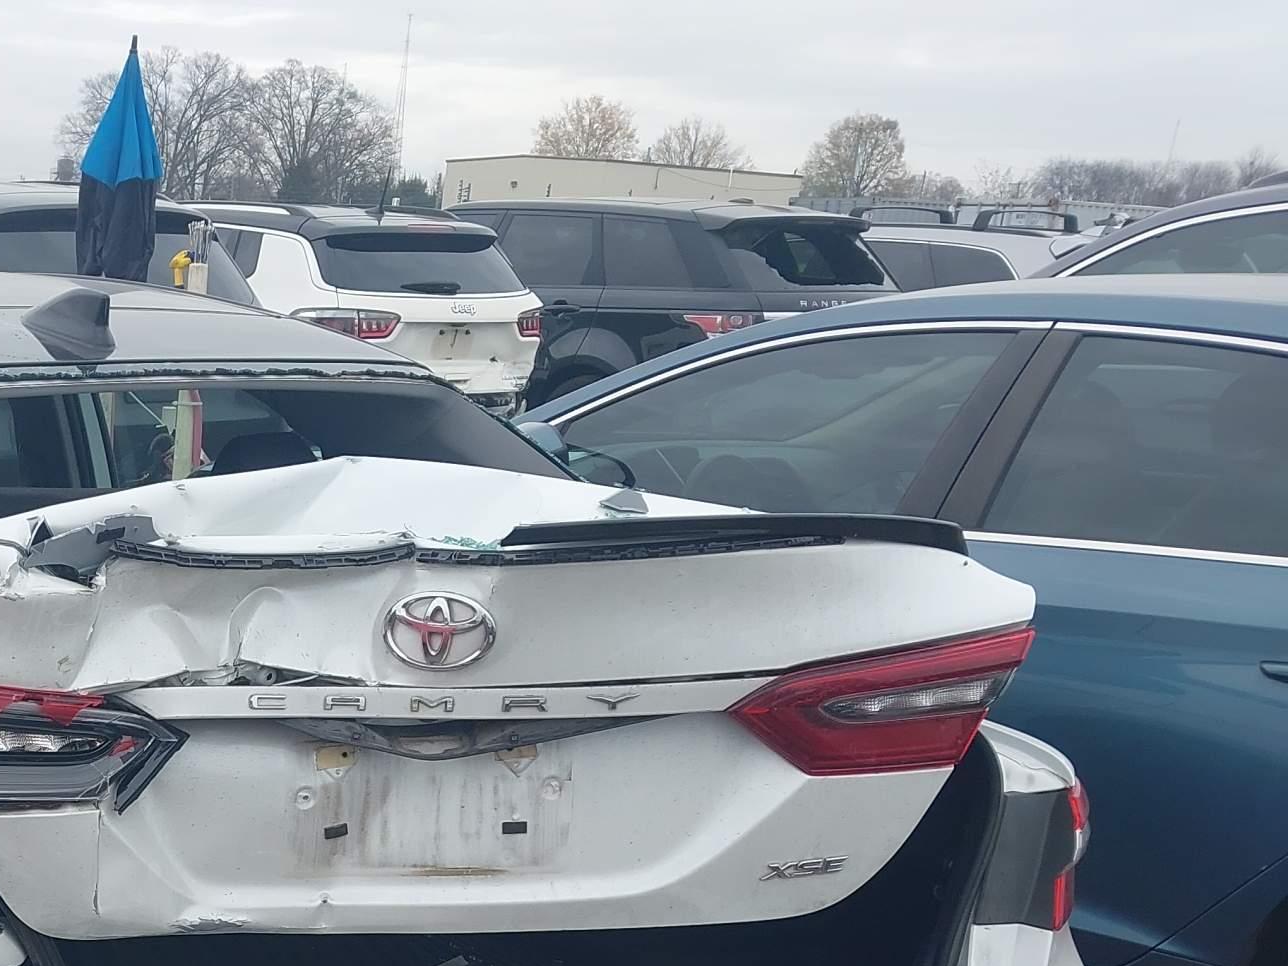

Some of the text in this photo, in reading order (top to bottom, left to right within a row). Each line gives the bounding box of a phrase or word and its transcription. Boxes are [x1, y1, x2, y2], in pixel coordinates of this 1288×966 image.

[450, 302, 477, 316] Jeep
[799, 300, 847, 308] RANGE
[248, 692, 642, 713] CAMRY
[759, 855, 848, 881] XSE
